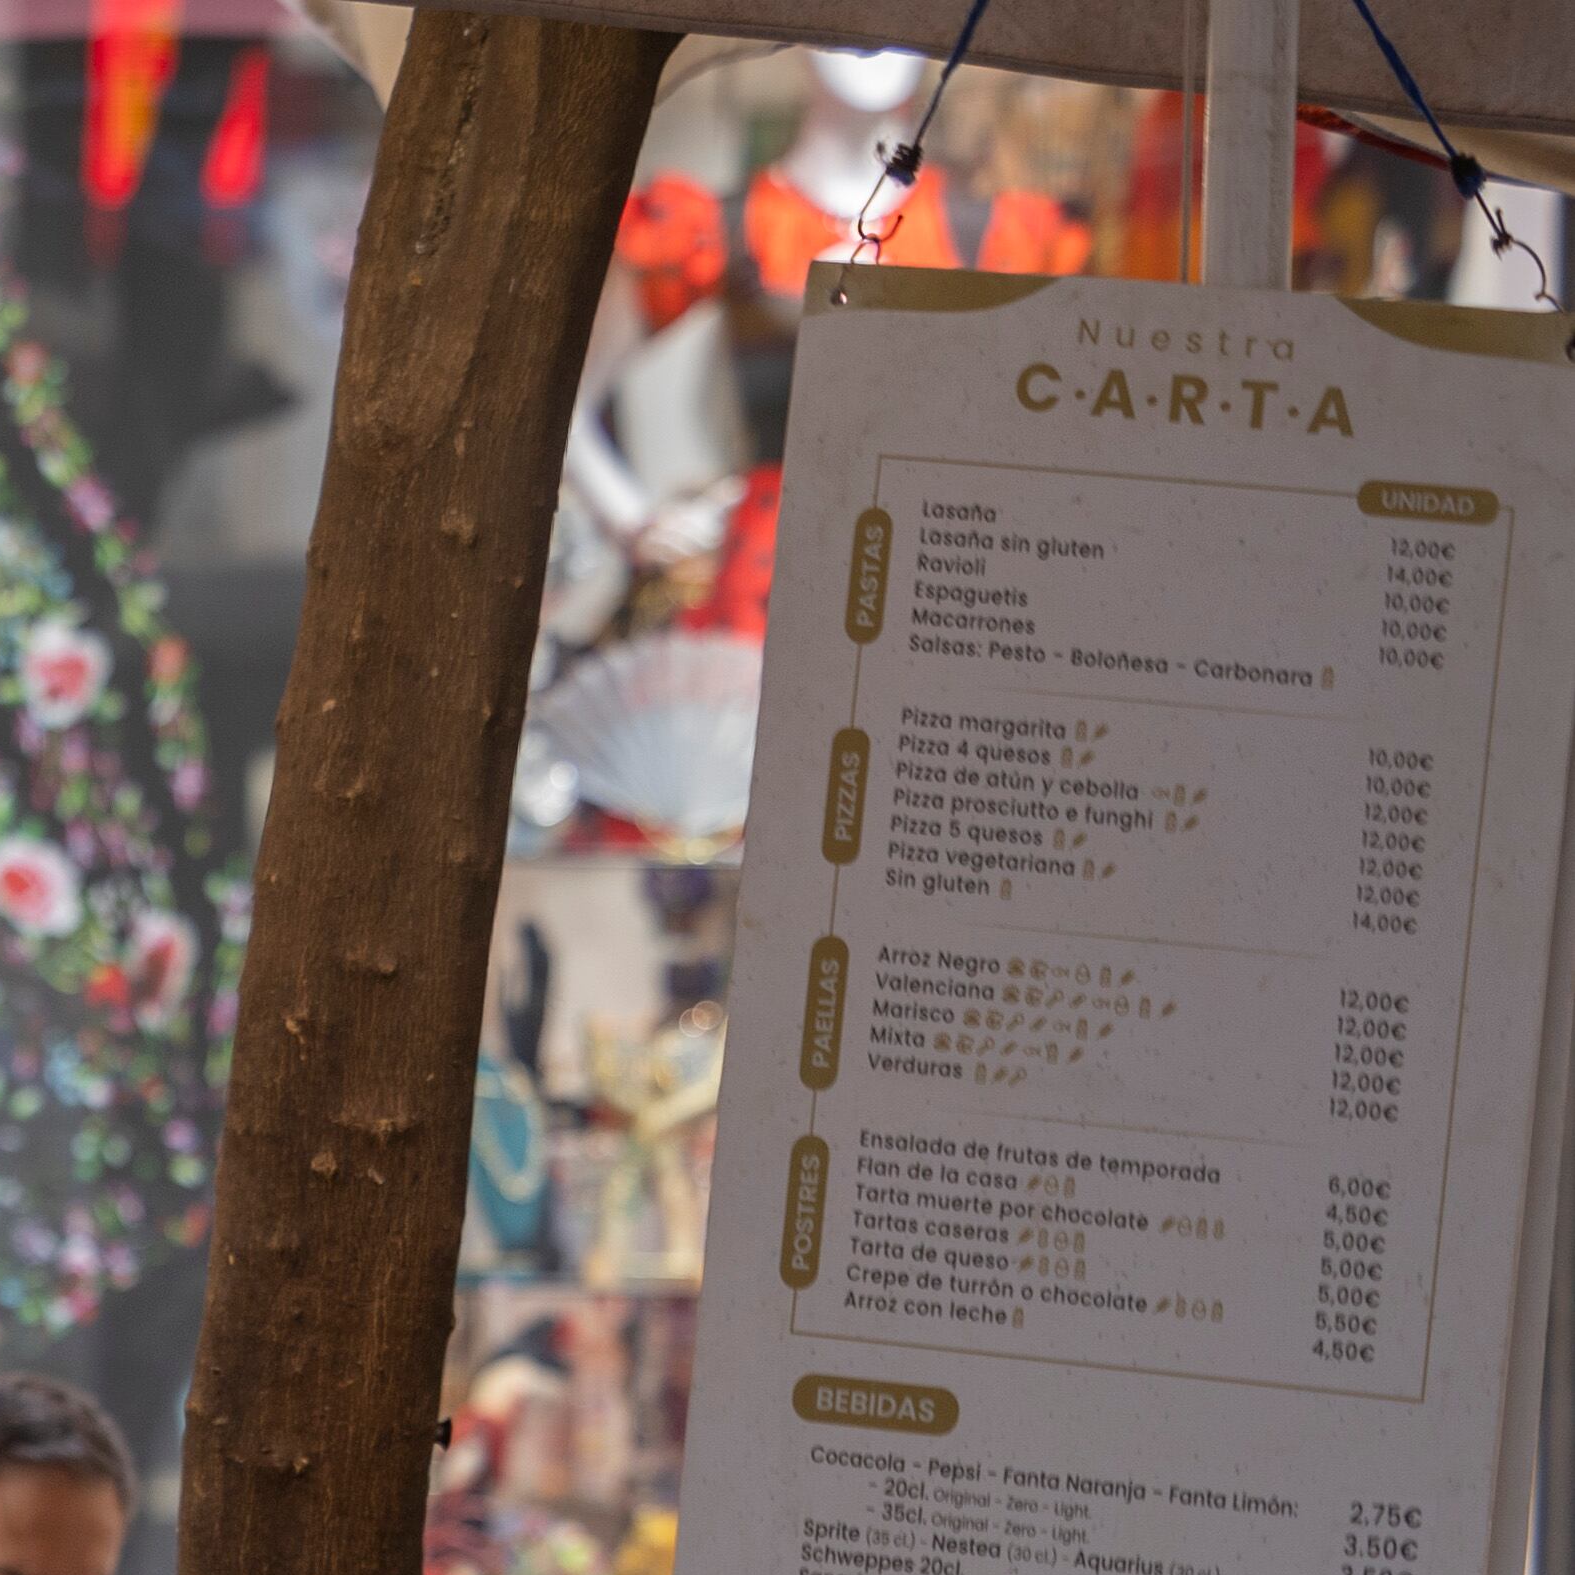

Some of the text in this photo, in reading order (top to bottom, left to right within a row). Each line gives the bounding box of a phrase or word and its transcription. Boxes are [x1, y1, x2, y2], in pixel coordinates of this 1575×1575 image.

[1077, 318, 1295, 362] Nuestra
[921, 499, 997, 523] Lasaña
[1380, 488, 1475, 517] UNIDAD
[919, 526, 1104, 561] Lasaña sin gluten
[1391, 537, 1455, 560] 12,00€
[856, 525, 884, 628] PASTAS
[916, 551, 986, 576] Ravioli
[1387, 564, 1452, 588] 14,00€
[913, 579, 1028, 608] Espaguetis
[1385, 592, 1449, 615] 10,00€
[911, 607, 1035, 635] Macarrones
[1381, 619, 1447, 642] 10,00€
[908, 633, 1313, 687] Salsas: Pesto Boloñesa Carbonara
[1379, 646, 1444, 670] 10,00€
[901, 706, 1066, 740] Pizza margarita
[897, 733, 1050, 765] Pizza 4 quesos
[1369, 747, 1433, 771] 10,00€
[894, 760, 1139, 800] Pizza de atún y cebolla
[1366, 775, 1431, 798] 10,00€
[835, 750, 860, 841] PIZZAS
[892, 787, 1153, 833] Pizza prosciutto e funghi
[1365, 802, 1428, 826] 12,00€
[890, 814, 1042, 846] Pizza 5 quesos
[1362, 829, 1425, 853] 12,00€
[887, 840, 1075, 876] Pizza vegetariana
[1359, 857, 1422, 880] 12,00€
[885, 867, 990, 896] Sin gluten
[1356, 884, 1420, 907] 12,00€
[1352, 910, 1417, 935] 14,00€
[877, 944, 1000, 978] Arroz Negro
[875, 971, 994, 1000] Valenciana
[811, 958, 840, 1068] PAELLAS
[872, 998, 954, 1023] Marisco
[1340, 987, 1409, 1014] 12,00€
[869, 1024, 925, 1047] Mixta
[1337, 1015, 1407, 1041] 12,00€
[867, 1051, 962, 1079] Verduras
[1334, 1042, 1404, 1068] 12,00€
[1332, 1069, 1401, 1095] 12,00€
[1329, 1096, 1398, 1123] 12,00€
[859, 1128, 1221, 1184] Ensalada de frutas de temporada
[856, 1155, 1017, 1190] Flan de la casa
[1328, 1174, 1391, 1200] 6,00€
[792, 1153, 821, 1270] POSTRES
[856, 1182, 1149, 1231] Tarta muerte por chocolate
[1325, 1203, 1388, 1227] 4,50€
[853, 1209, 1009, 1243] Tartas caseras
[850, 1235, 1009, 1271] Tarta de queso
[1323, 1229, 1385, 1254] 5,00€
[1320, 1255, 1383, 1281] 5,00€
[846, 1262, 1148, 1313] Crepe de turrón o chocolate
[1318, 1283, 1380, 1309] 5,00€
[843, 1289, 1007, 1325] Arroz con leche
[1314, 1310, 1377, 1336] 5,50€
[1311, 1338, 1374, 1363] 4,50€
[816, 1385, 935, 1423] BEBIDAS
[810, 1444, 1298, 1518] Cocacola Pepsi Fanta Naranja Fanta Limón:
[803, 1516, 860, 1543] Sprite
[931, 1532, 1002, 1559] Nestea
[801, 1542, 915, 1575] Schweppes
